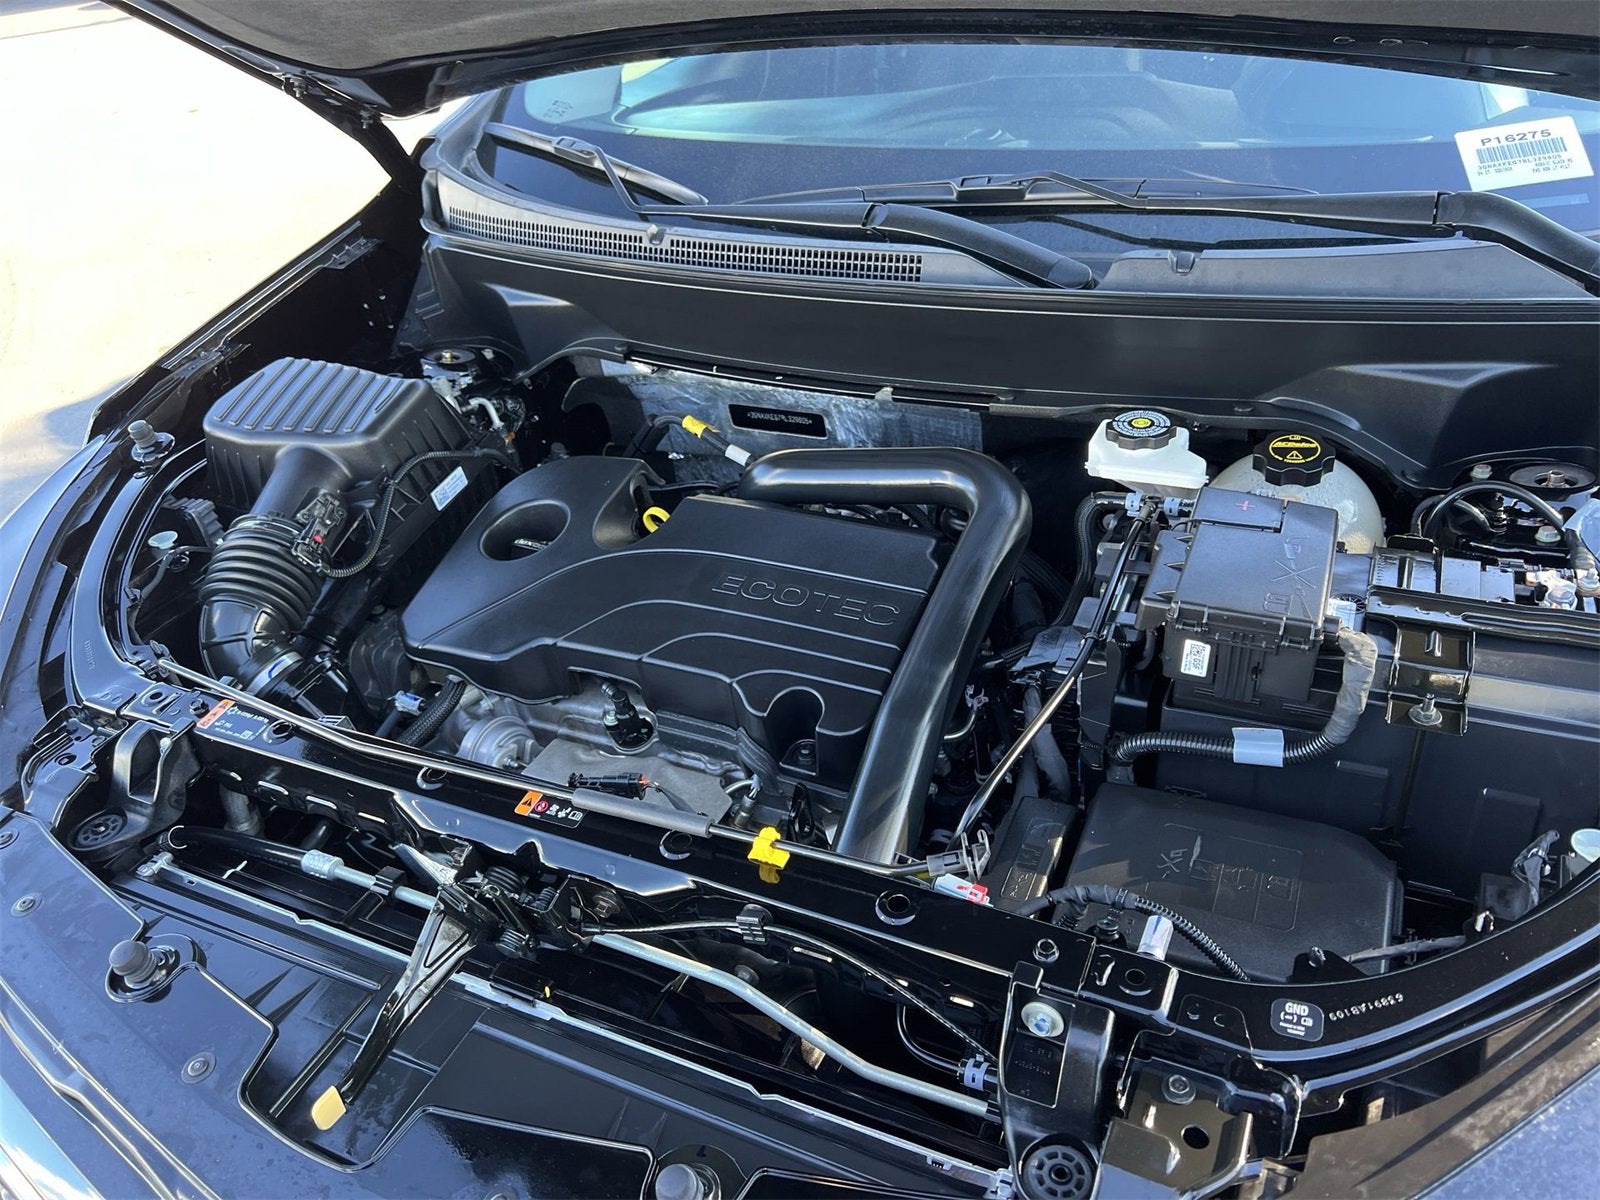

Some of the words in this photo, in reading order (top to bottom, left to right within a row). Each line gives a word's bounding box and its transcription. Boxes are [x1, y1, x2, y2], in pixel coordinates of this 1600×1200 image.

[1481, 129, 1552, 146] P16275
[712, 574, 899, 627] ECOTEC
[1285, 1002, 1309, 1016] GND
